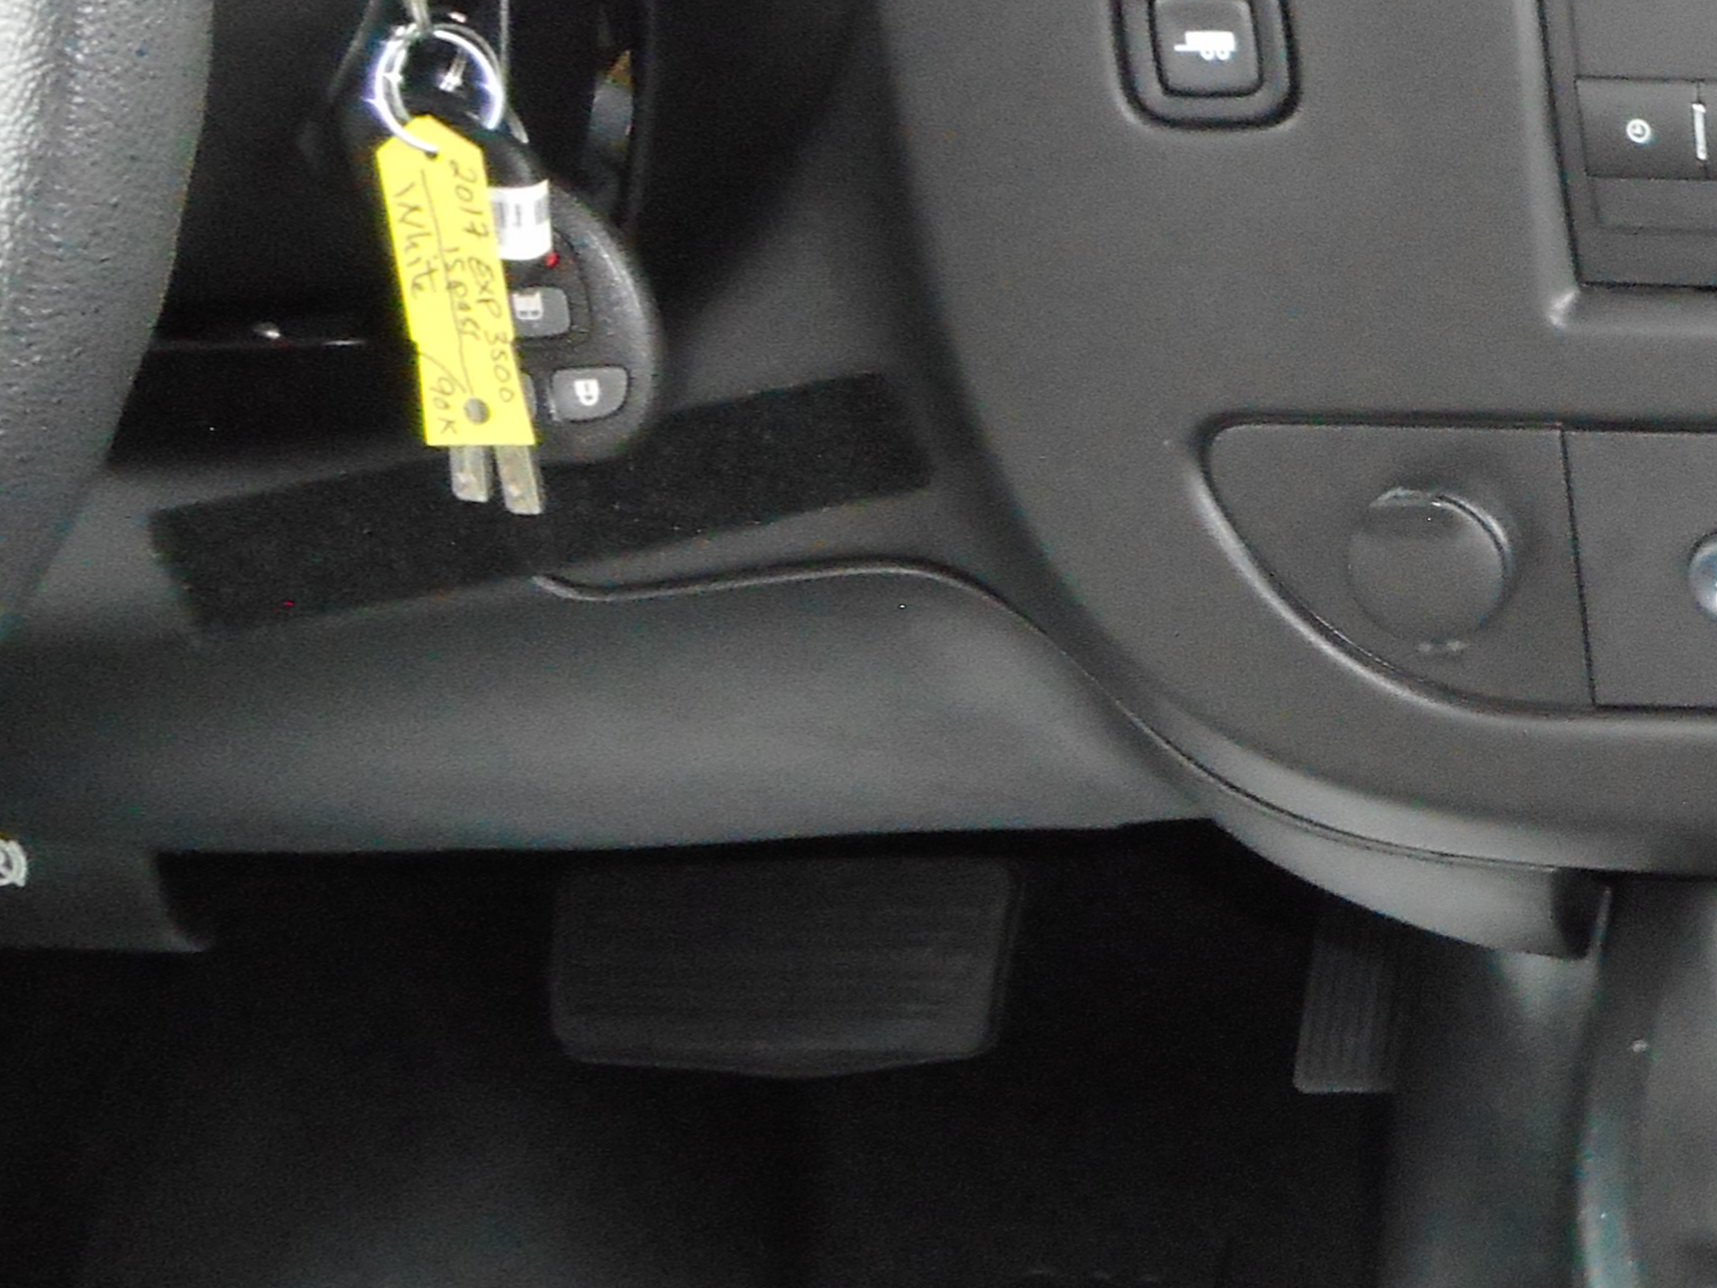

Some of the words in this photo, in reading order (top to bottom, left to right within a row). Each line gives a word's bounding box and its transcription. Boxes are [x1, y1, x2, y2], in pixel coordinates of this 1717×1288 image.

[391, 180, 440, 299] White
[449, 160, 488, 237] 2017
[483, 331, 515, 403] 3500
